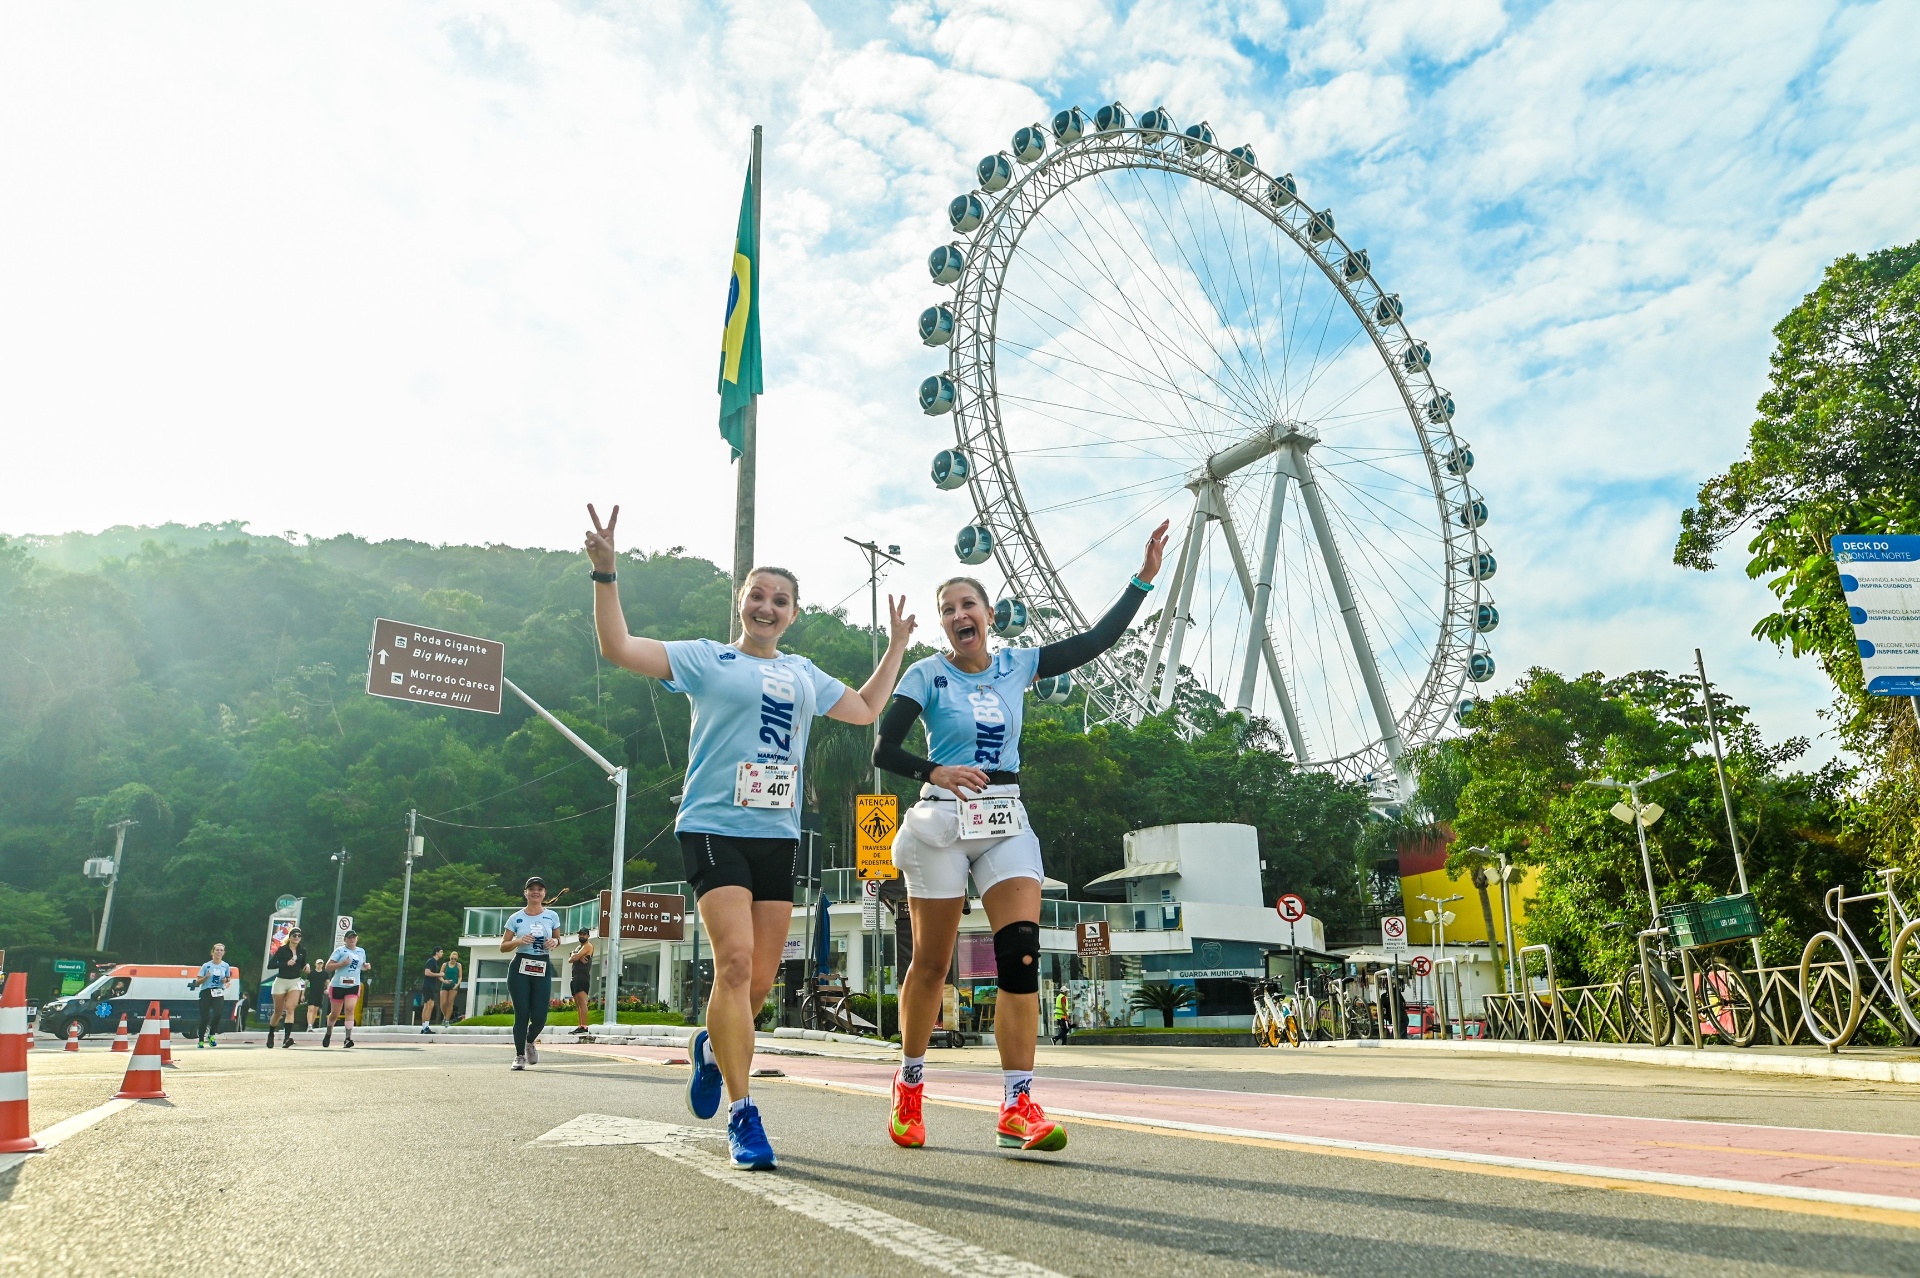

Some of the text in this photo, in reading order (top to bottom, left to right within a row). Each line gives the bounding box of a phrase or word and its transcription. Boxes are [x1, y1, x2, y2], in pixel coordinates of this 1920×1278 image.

[1842, 542, 1889, 550] DECK DO
[1847, 552, 1912, 560] ONTAL NORTE
[414, 632, 487, 655] Roda Gigante
[412, 649, 469, 667] Big Wheel
[410, 669, 495, 692] Morro do Careca
[408, 685, 472, 703] Careca Hill
[767, 782, 790, 796] 407
[858, 797, 896, 807] ATENÇÃO
[988, 811, 1012, 825] 421
[626, 899, 659, 909] Deck do
[602, 910, 659, 921] Ptal Norte
[619, 924, 658, 933] rth Deck
